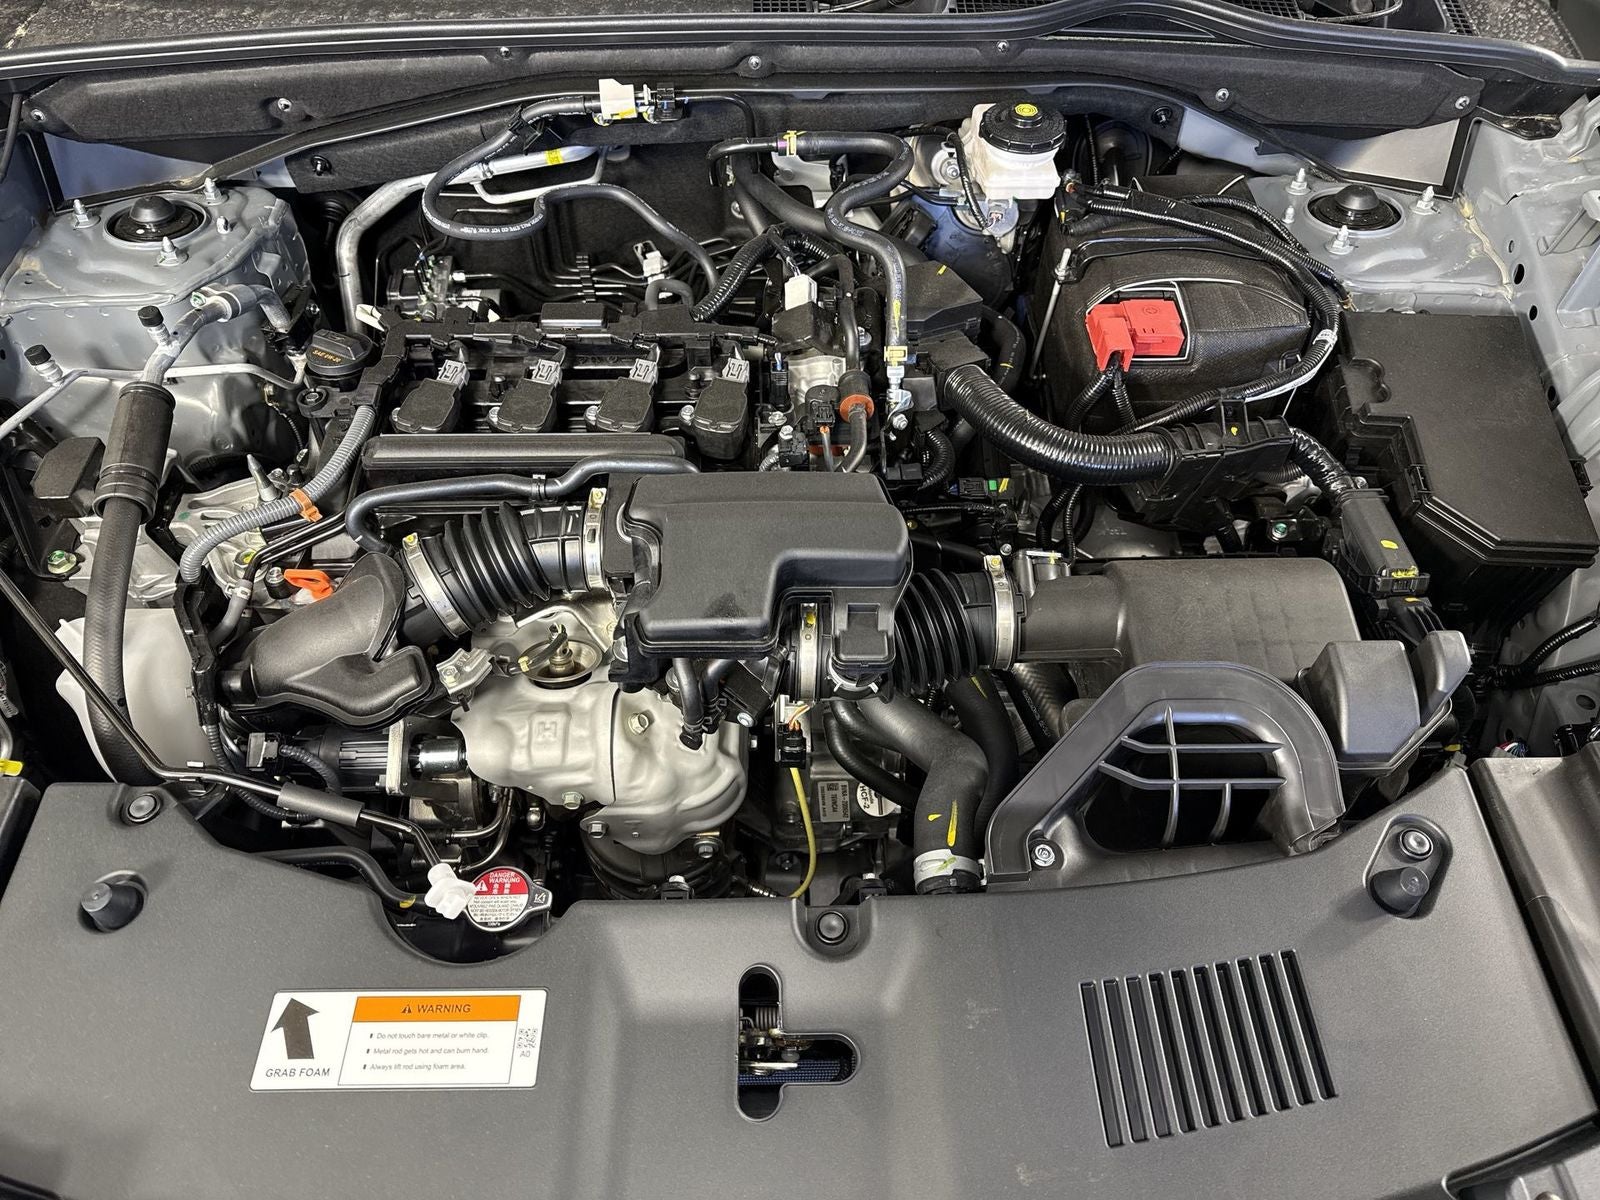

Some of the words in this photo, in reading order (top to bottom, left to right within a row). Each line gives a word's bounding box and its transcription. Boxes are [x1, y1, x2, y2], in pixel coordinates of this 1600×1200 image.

[860, 785, 870, 809] HCF-2
[416, 1004, 471, 1013] WARNING
[376, 1032, 387, 1040] Do
[387, 1032, 398, 1040] not
[398, 1032, 416, 1040] touch
[373, 1047, 391, 1055] Metal
[392, 1047, 403, 1055] rod
[404, 1048, 417, 1056] gets
[418, 1047, 429, 1055] hot
[430, 1047, 442, 1055] and
[369, 1063, 392, 1072] Always
[393, 1063, 402, 1071] lift
[402, 1063, 414, 1071] rod
[414, 1063, 431, 1072] using
[265, 1067, 296, 1078] GRAB
[299, 1067, 330, 1077] FOAM
